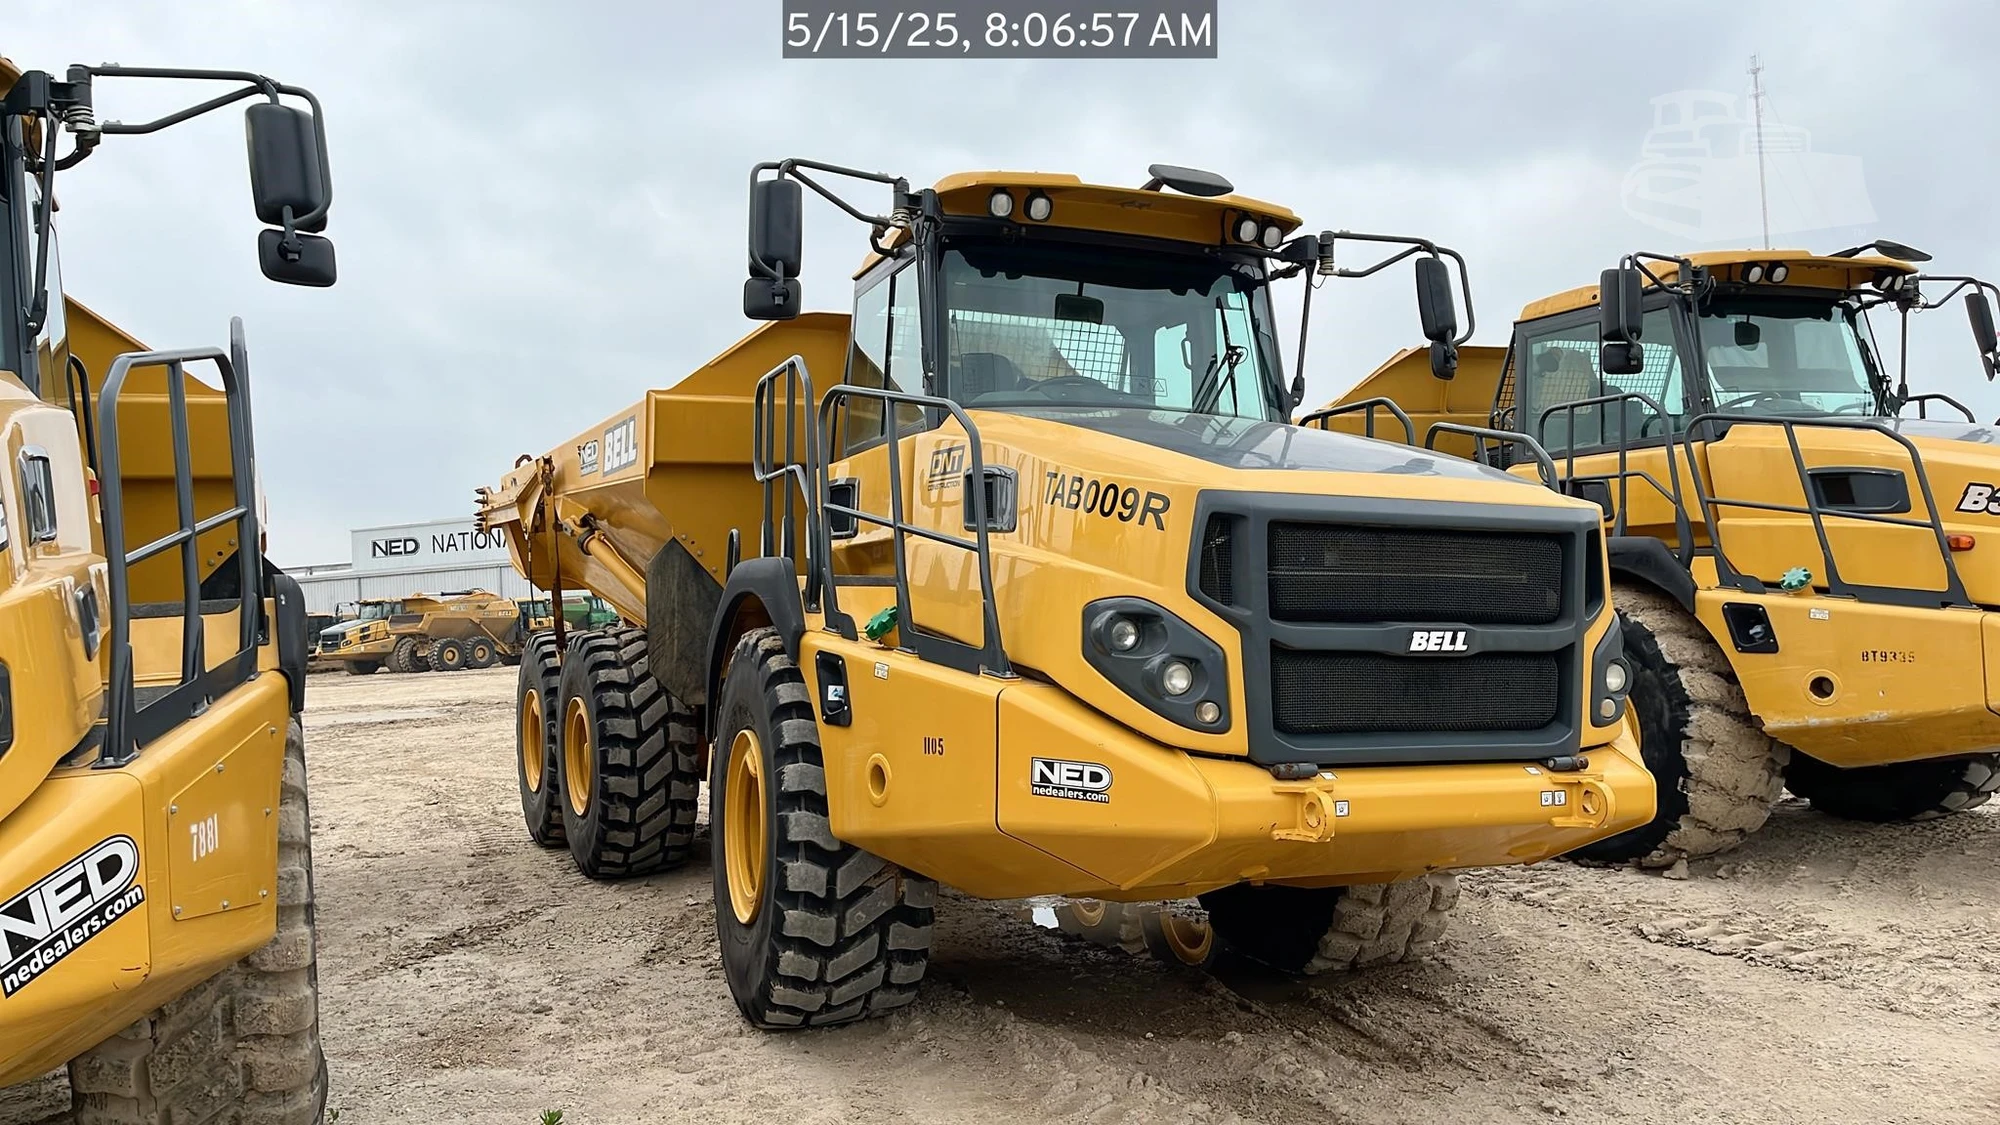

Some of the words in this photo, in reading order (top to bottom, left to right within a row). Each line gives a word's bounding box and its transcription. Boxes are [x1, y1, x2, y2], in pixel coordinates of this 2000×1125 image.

[603, 418, 638, 475] BELL
[931, 448, 964, 475] DNT
[1045, 471, 1171, 531] TAB009R
[372, 539, 419, 557] NED
[1409, 631, 1469, 652] BELL
[923, 737, 944, 756] 1105
[1033, 760, 1110, 790] NED
[1033, 786, 1109, 803] nedealers.com
[190, 813, 218, 862] 7881
[0, 840, 136, 966] NED
[4, 886, 143, 993] nedealers.com
